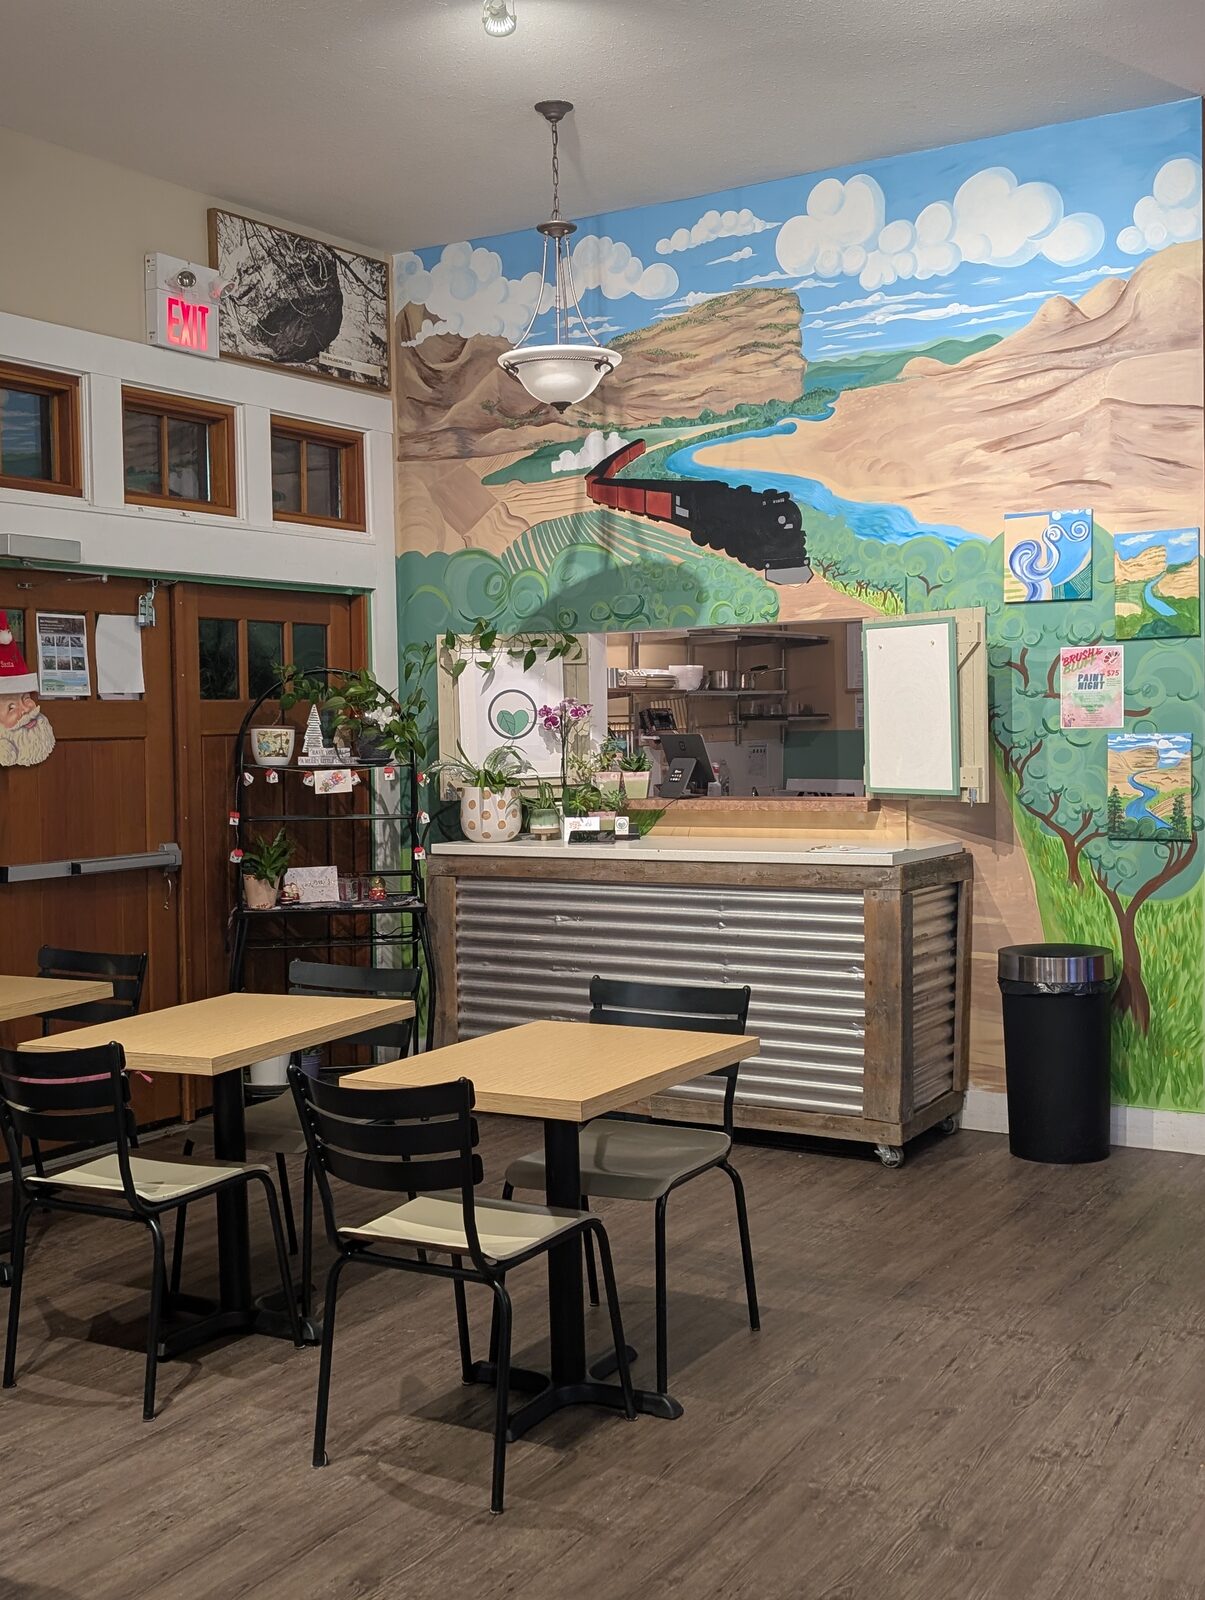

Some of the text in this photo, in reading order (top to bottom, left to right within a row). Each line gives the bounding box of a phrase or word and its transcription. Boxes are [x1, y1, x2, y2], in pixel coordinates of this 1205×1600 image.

[168, 297, 209, 351] EXIT
[1062, 648, 1096, 667] BRUSH
[1063, 656, 1097, 674] BLUFF
[1077, 673, 1105, 682] PAINT
[1106, 669, 1120, 677] $75
[1077, 681, 1105, 690] NIGHT
